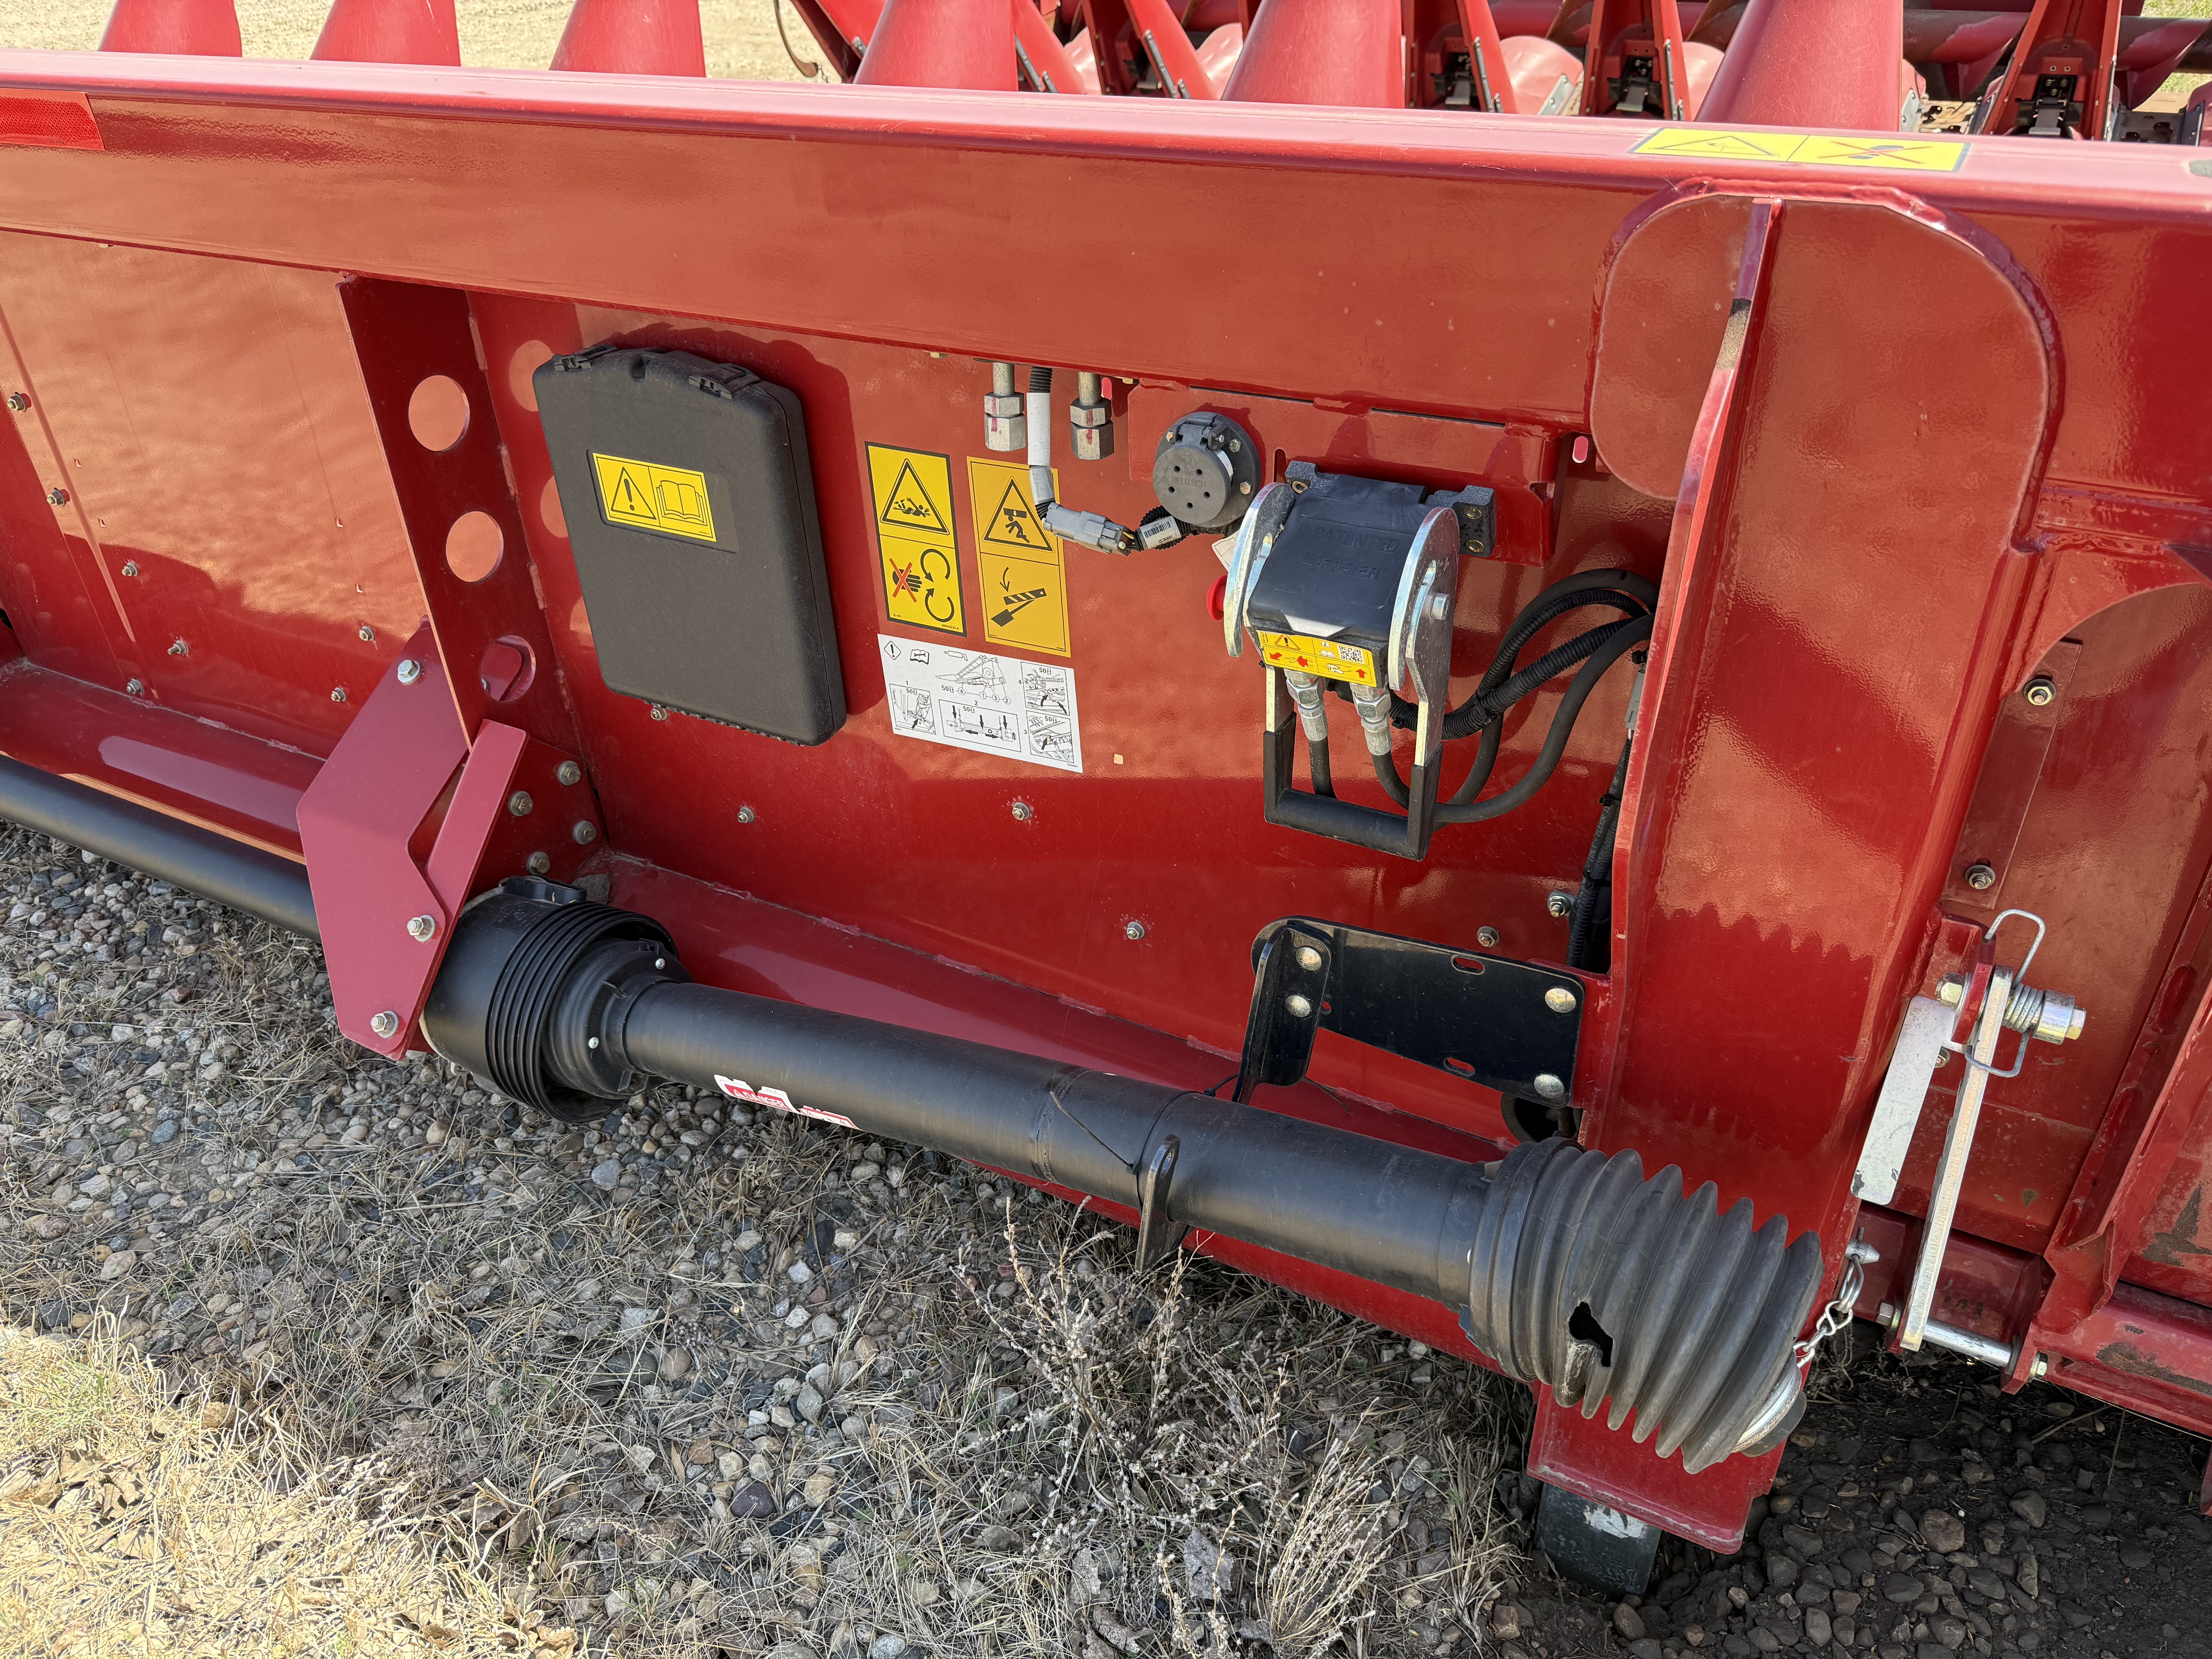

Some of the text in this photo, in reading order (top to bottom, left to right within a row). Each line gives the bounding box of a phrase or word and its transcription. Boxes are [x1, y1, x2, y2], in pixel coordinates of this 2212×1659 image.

[1171, 476, 1206, 488] DEUTSCH
[1313, 526, 1400, 553] PATENTED
[1588, 843, 1597, 862] ITALY
[1596, 814, 1607, 837] FLEXOR
[742, 1091, 786, 1109] DANGER
